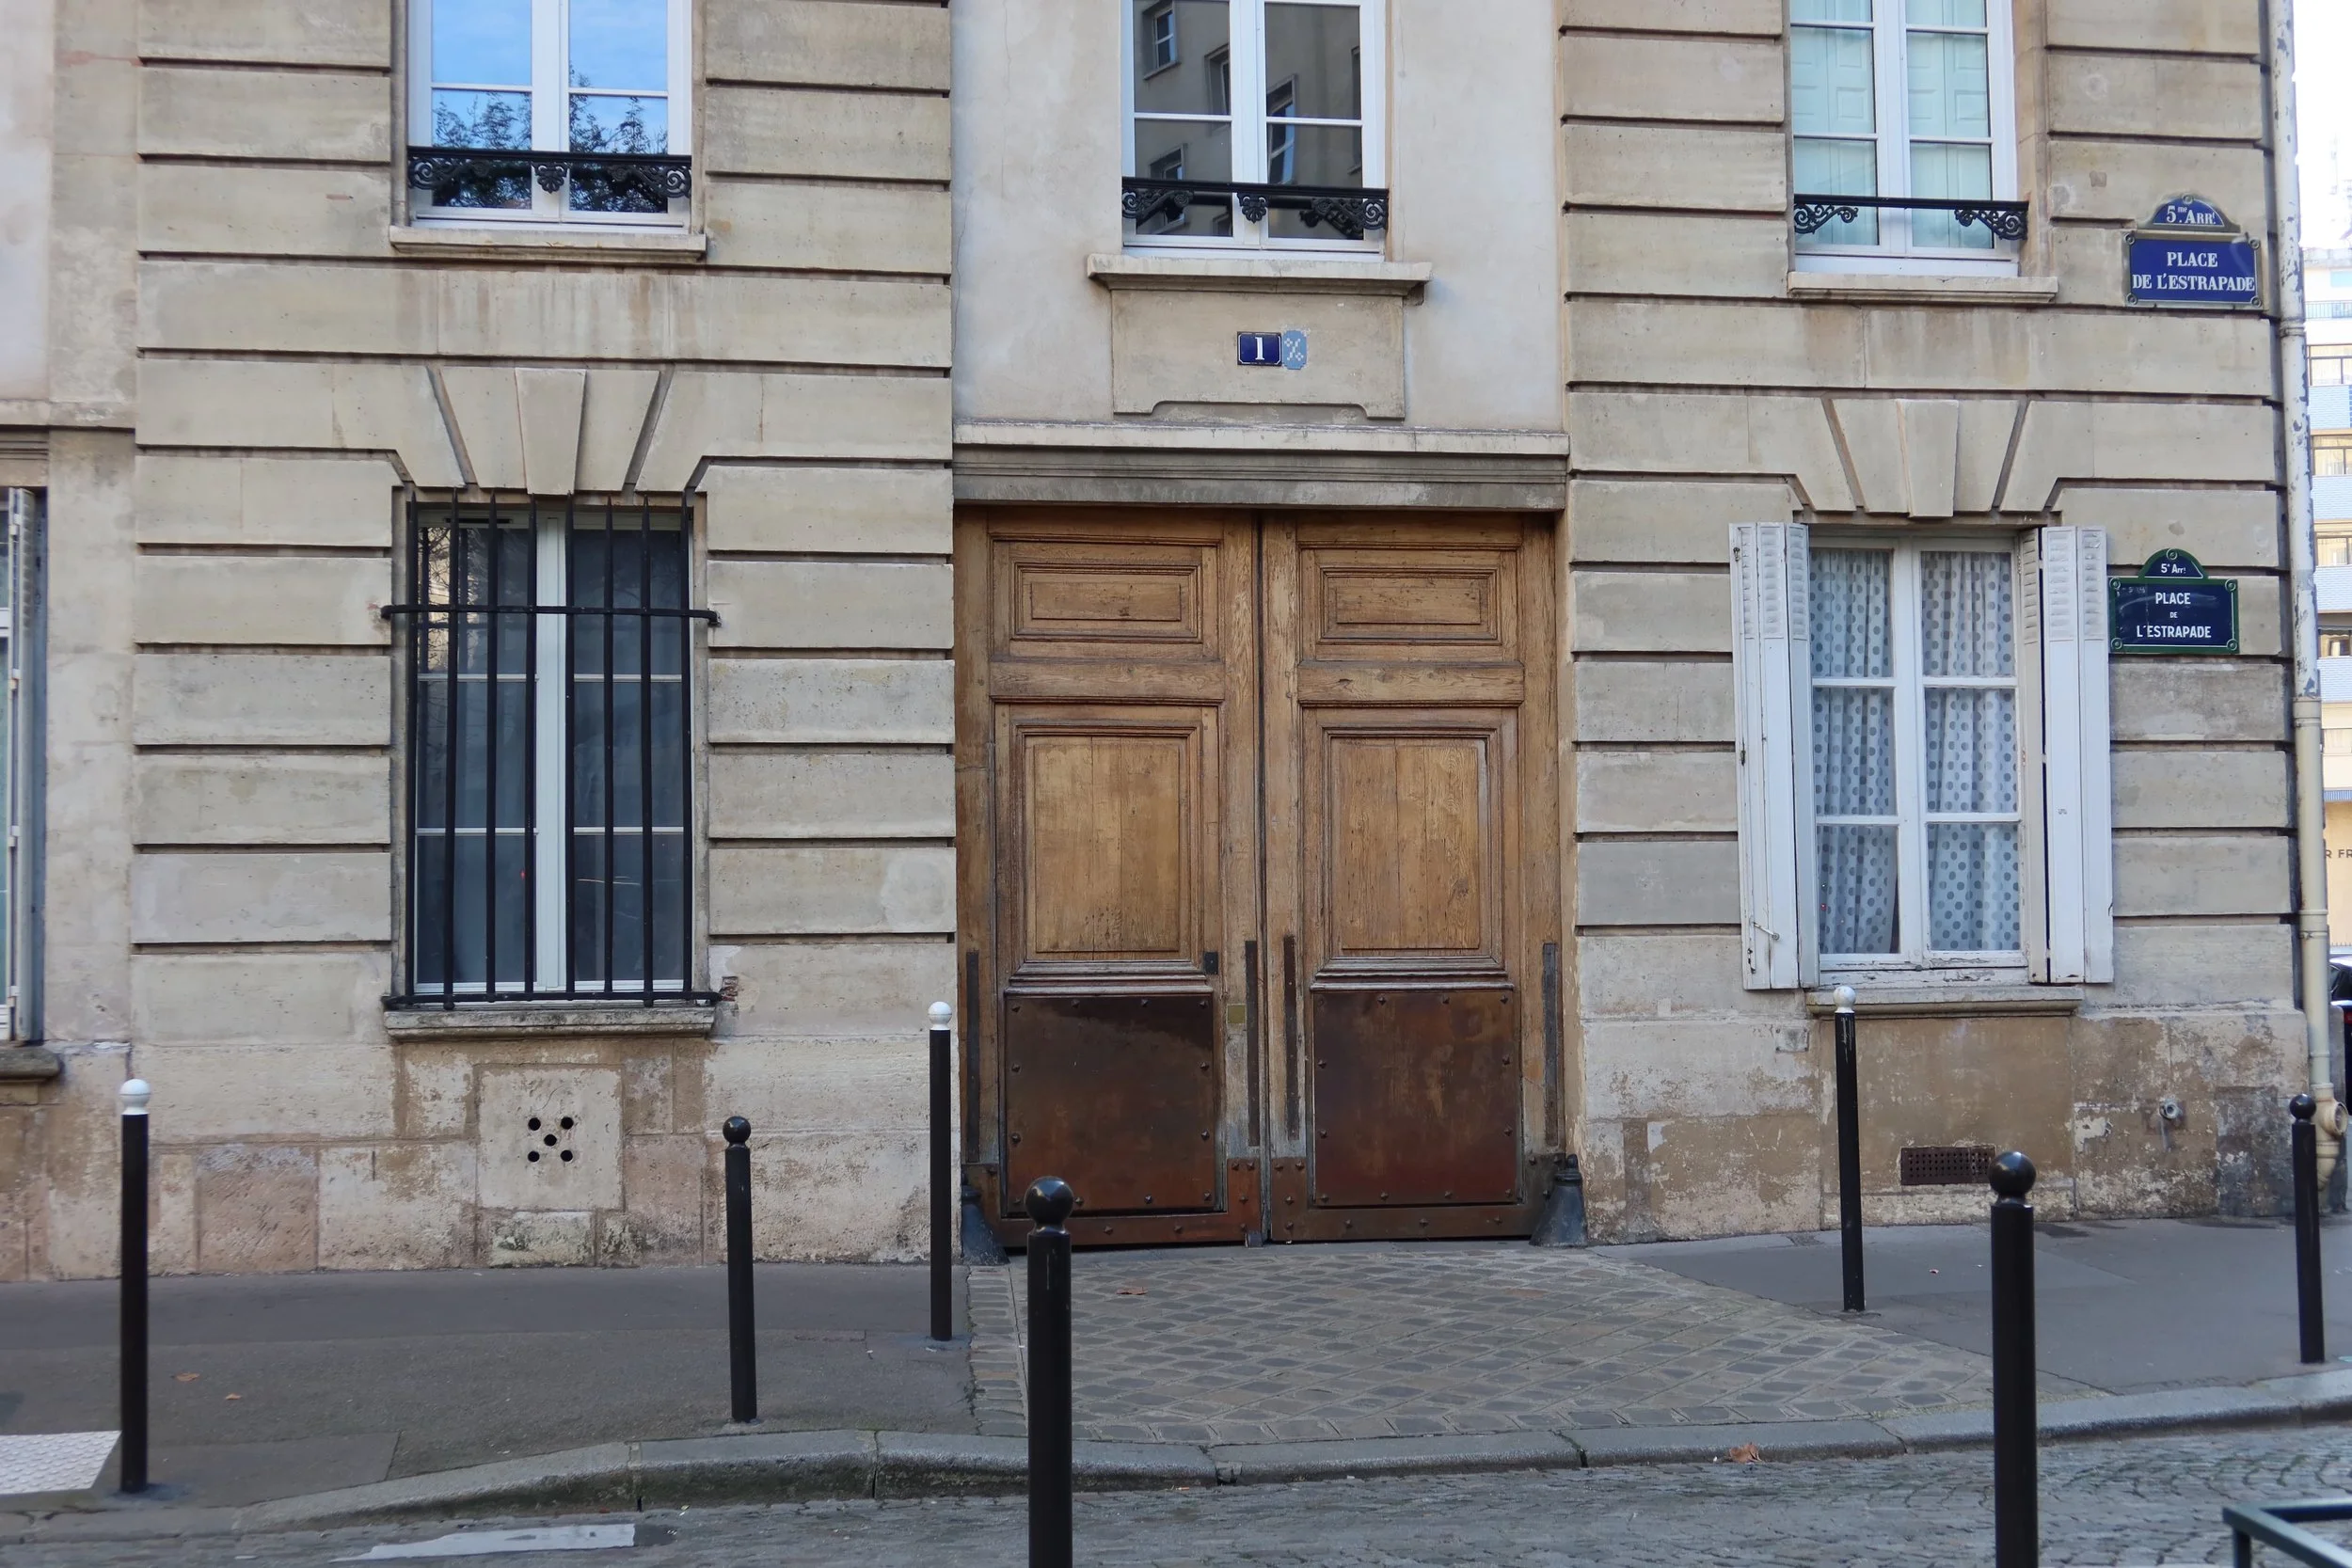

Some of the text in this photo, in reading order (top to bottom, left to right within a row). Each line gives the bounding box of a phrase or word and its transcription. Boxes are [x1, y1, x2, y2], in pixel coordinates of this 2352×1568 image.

[2167, 251, 2218, 268] PLACE
[2132, 273, 2255, 292] DE L'ESTRAPADE
[1254, 336, 1265, 360] 1
[2155, 592, 2191, 605] PLACE
[2136, 625, 2212, 639] L'ESTRAPADE
